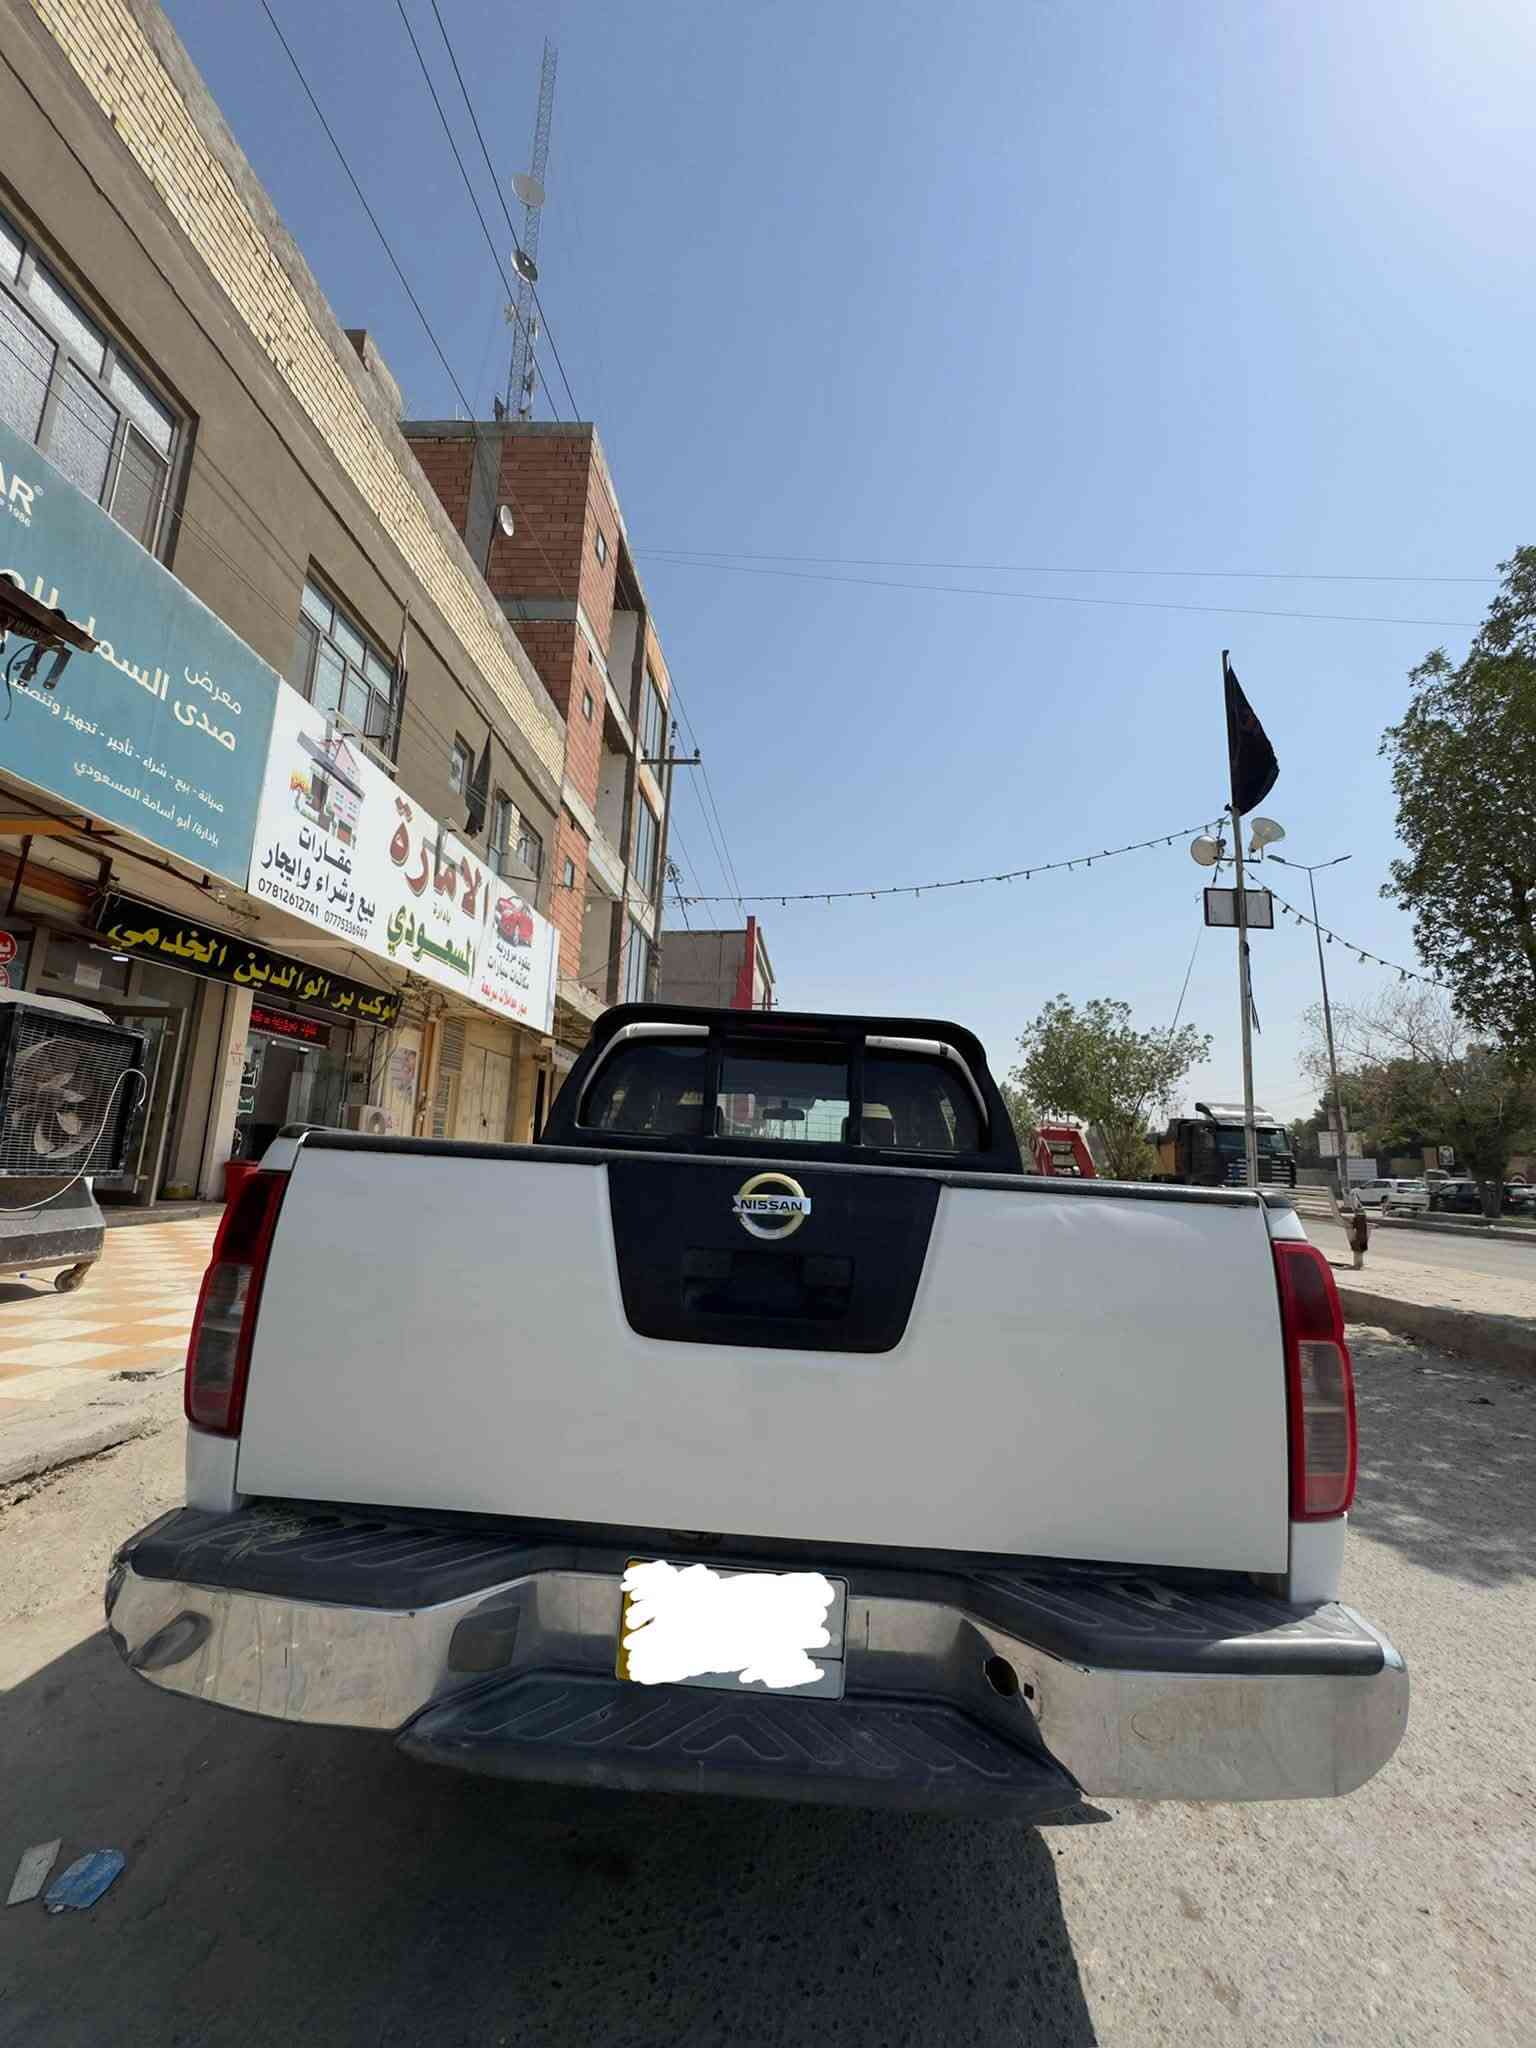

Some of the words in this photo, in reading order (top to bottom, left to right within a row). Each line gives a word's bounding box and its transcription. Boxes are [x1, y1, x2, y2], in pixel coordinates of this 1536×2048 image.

[184, 666, 242, 715] معرض
[174, 701, 236, 751] صدى
[73, 761, 141, 801] المسعودي
[298, 826, 353, 875] عقارات
[357, 897, 376, 924] بيع
[107, 924, 228, 967] الخدمي
[233, 952, 330, 1000] الوالدين
[740, 1199, 802, 1211] NISSAN
